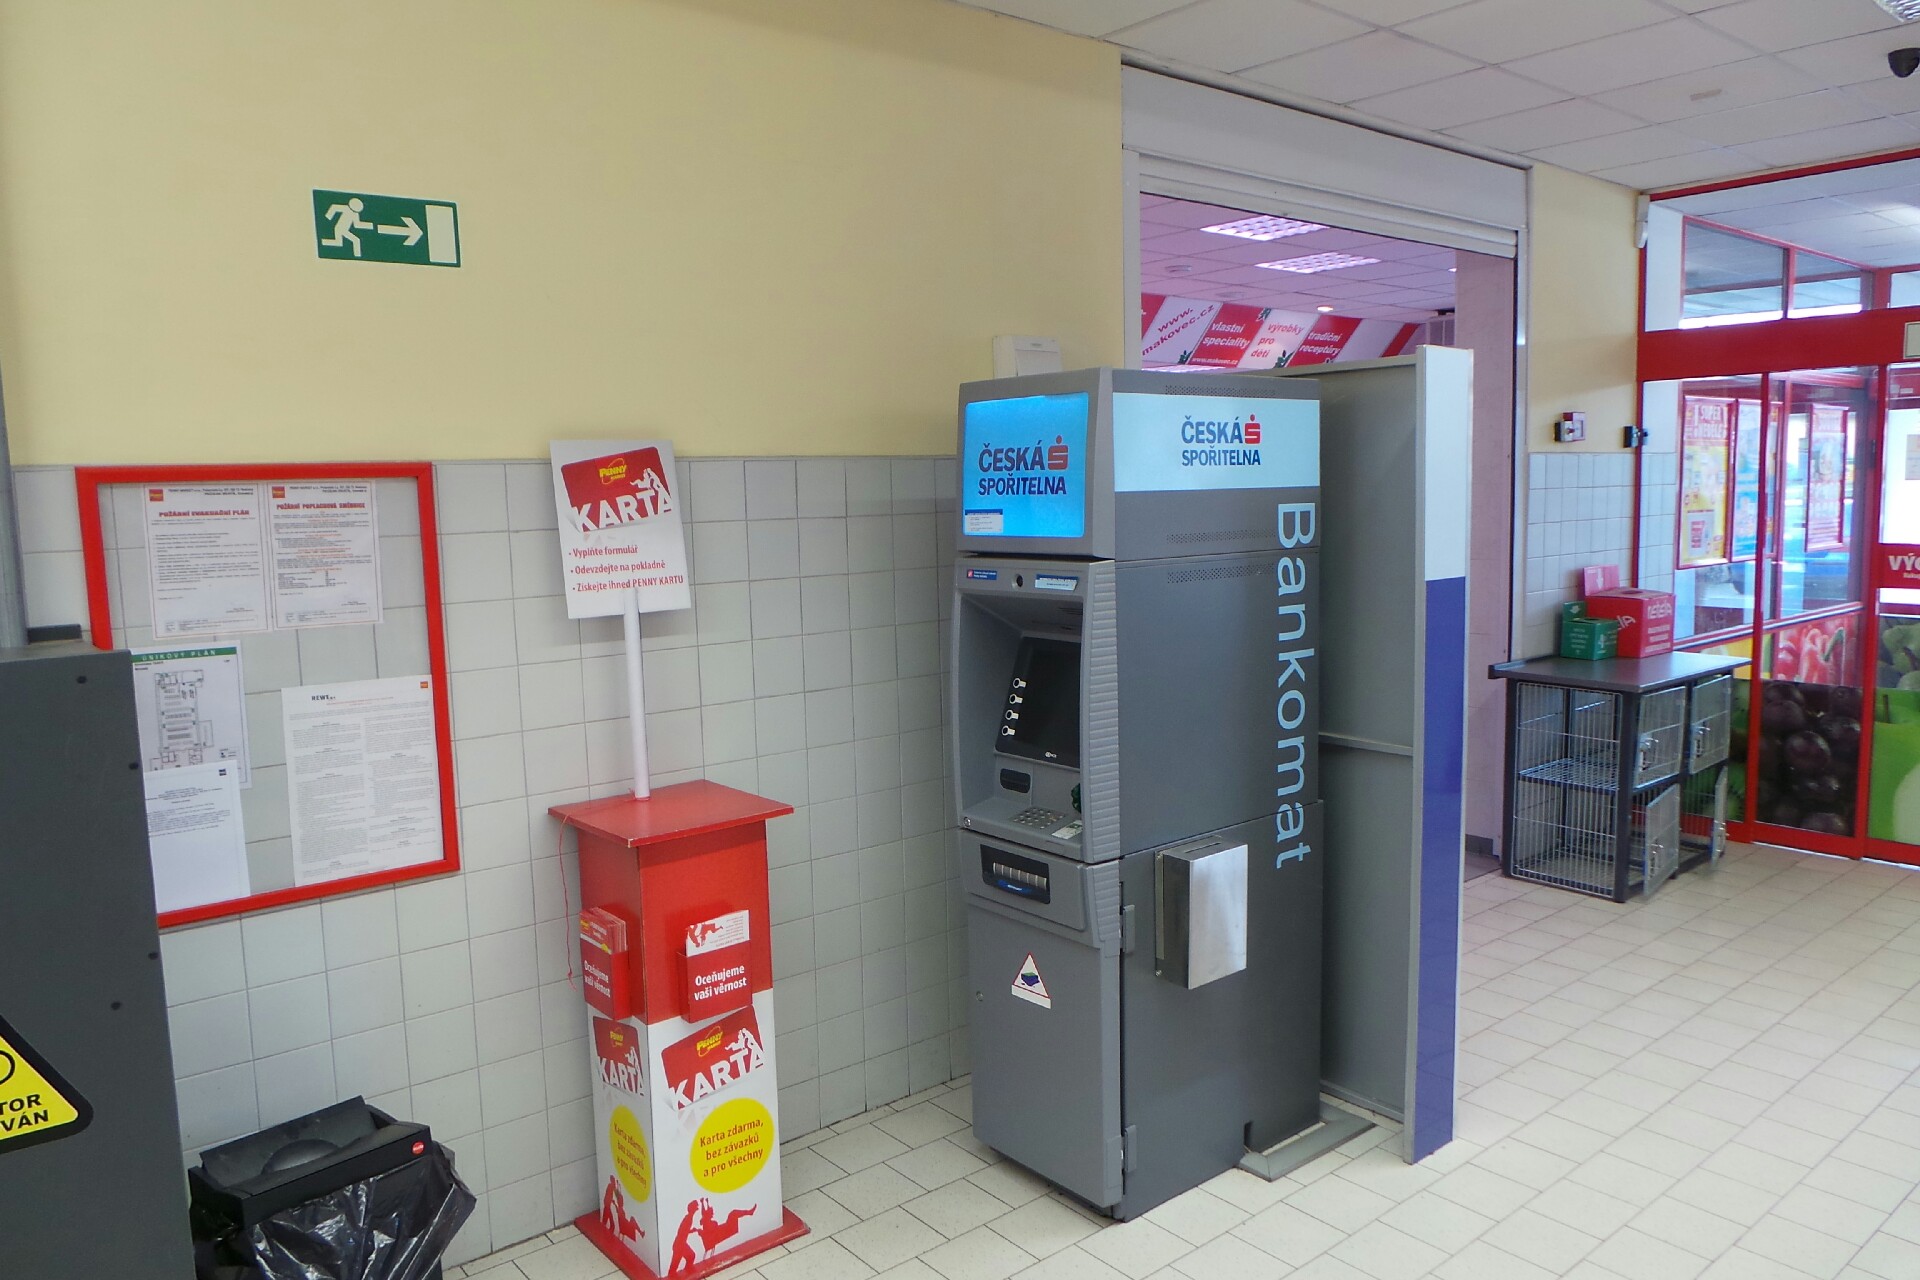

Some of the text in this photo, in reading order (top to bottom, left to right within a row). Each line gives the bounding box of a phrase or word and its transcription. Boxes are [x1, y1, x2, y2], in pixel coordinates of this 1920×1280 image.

[1267, 322, 1305, 335] výrobky
[1203, 336, 1250, 349] speciality
[1258, 337, 1275, 345] pro
[1251, 348, 1270, 358] děti
[1181, 415, 1244, 444] ČESKÁ
[978, 440, 1046, 472] ČESKÁ
[1182, 445, 1261, 466] SPOŘITELNA
[978, 473, 1067, 496] SPOŘITELNA
[571, 486, 673, 533] KARTA
[573, 545, 639, 559] Vyplňte formulář
[574, 560, 666, 574] Odevzdejte na pokladně
[577, 575, 684, 592] Získejte ihned PENNY KARTU
[1275, 502, 1317, 870] Bankomat
[695, 965, 745, 986] Oceňujeme
[694, 977, 748, 1001] vaši věrnost
[600, 1057, 645, 1097] KARTA
[669, 1048, 764, 1111] KARTA
[0, 1109, 49, 1132] VÁN
[700, 1119, 764, 1147] Karta zdarma,
[706, 1132, 760, 1160] bez závazků
[704, 1149, 764, 1177] a pro všechny
